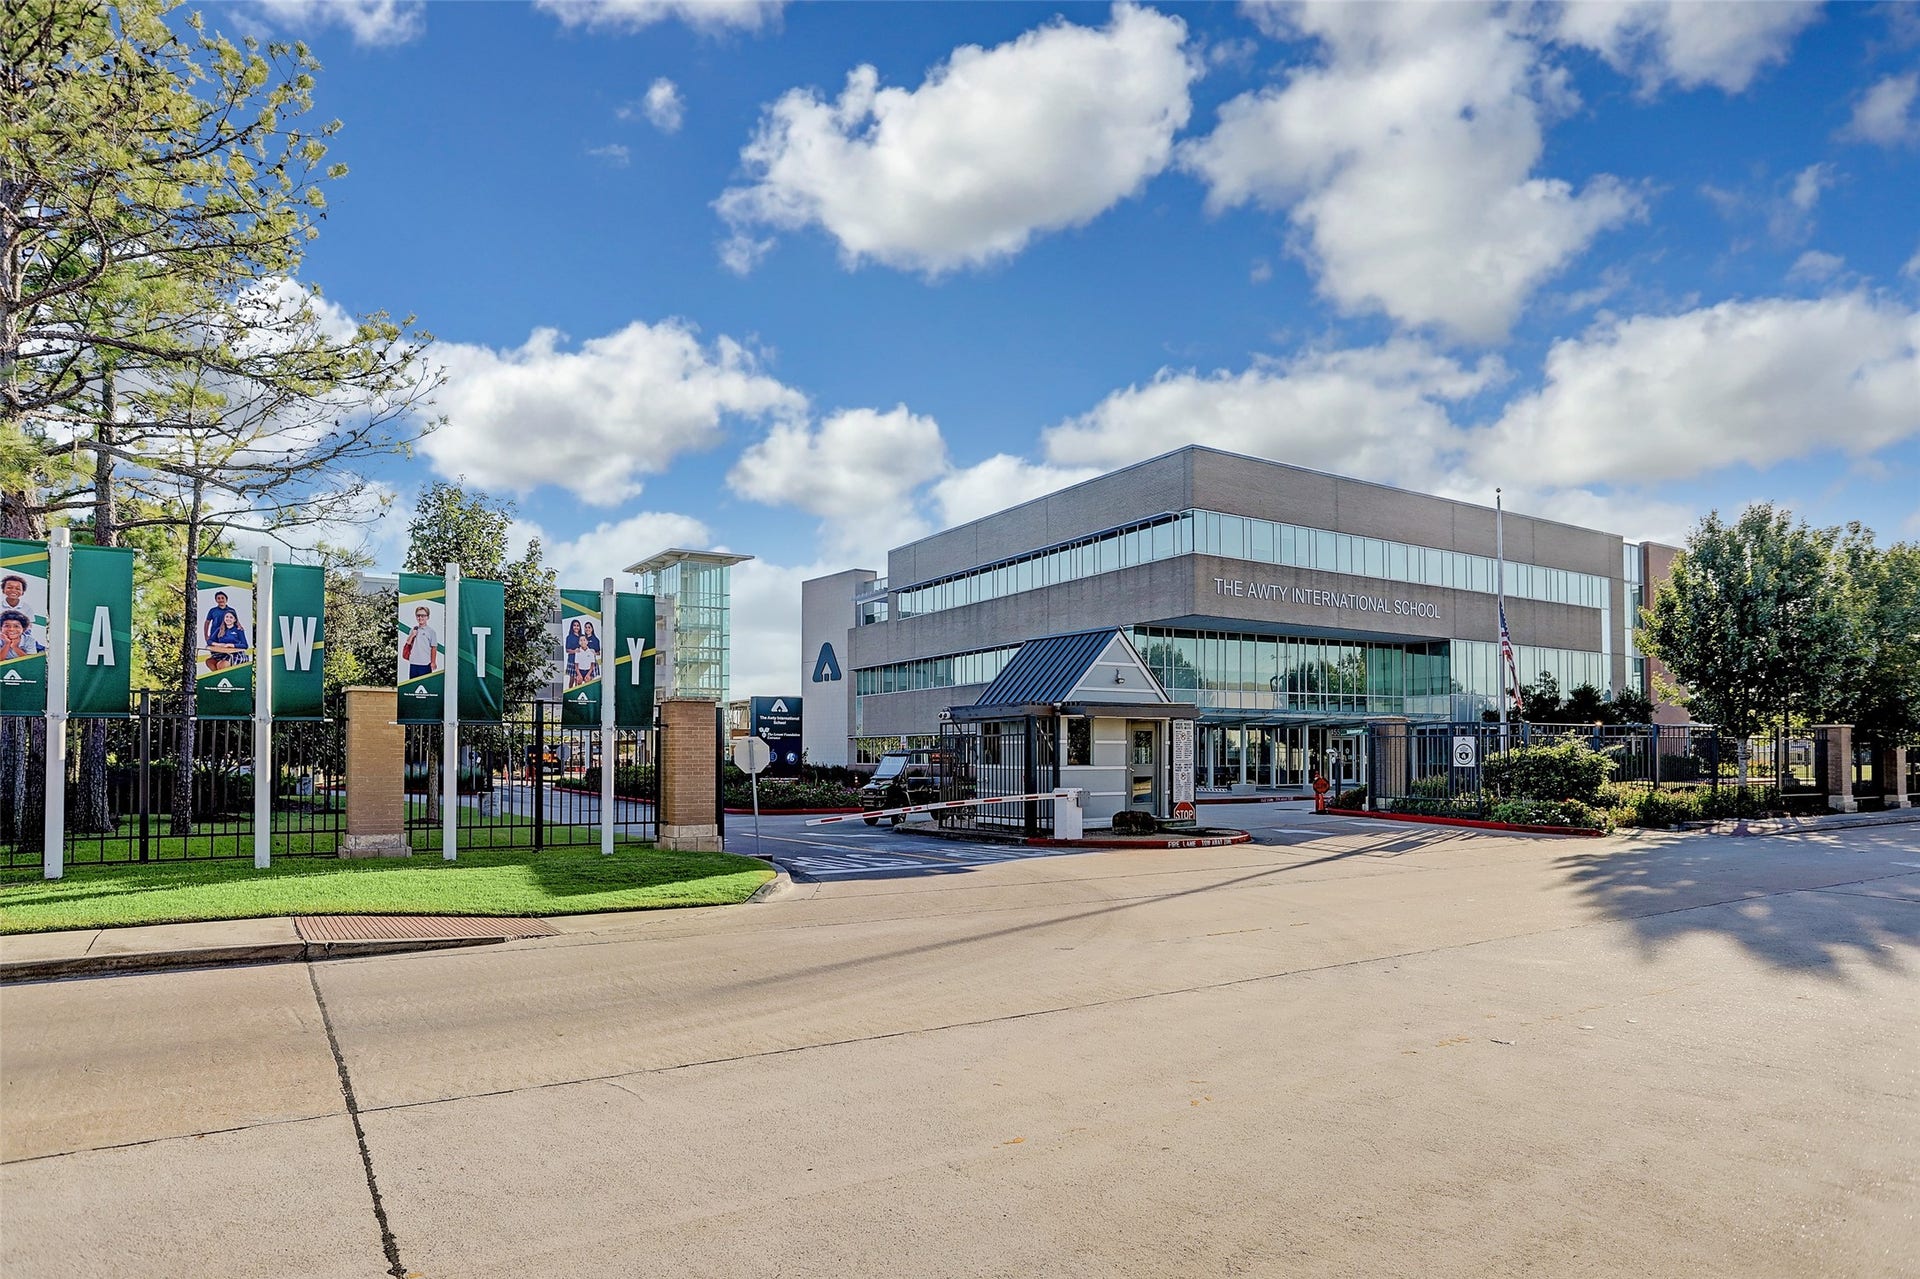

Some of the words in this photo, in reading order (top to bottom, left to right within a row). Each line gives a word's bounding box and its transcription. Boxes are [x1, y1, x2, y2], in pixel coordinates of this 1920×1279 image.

[1214, 578, 1243, 598] THE
[1247, 582, 1288, 602] AWTY
[1291, 587, 1391, 615] INTERNATIONAL
[1393, 599, 1441, 619] SCHOOL
[86, 605, 116, 667] A
[278, 615, 317, 672] W
[471, 626, 492, 678] T
[626, 637, 646, 686] Y
[1175, 809, 1194, 820] STOP
[1182, 840, 1197, 848] LANE
